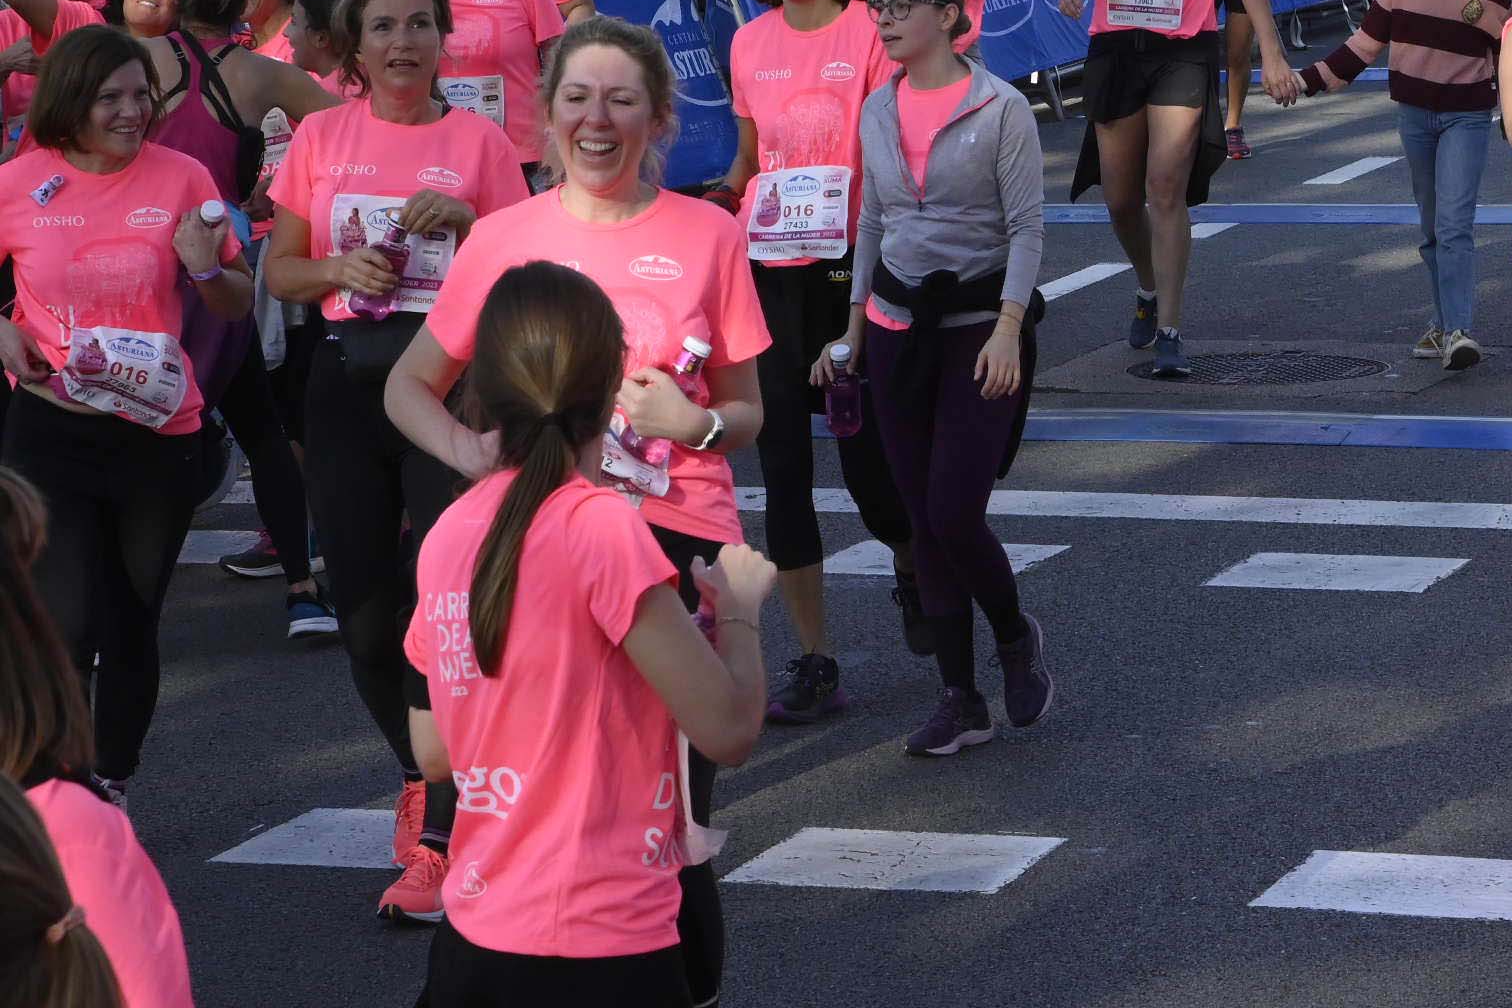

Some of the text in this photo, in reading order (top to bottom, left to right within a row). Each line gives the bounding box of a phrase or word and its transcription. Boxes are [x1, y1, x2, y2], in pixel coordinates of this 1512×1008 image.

[755, 68, 792, 81] OYSHO
[783, 203, 814, 218] 016
[33, 215, 85, 228] OYSHO
[783, 220, 809, 230] 27433
[401, 295, 435, 305] Santande
[110, 362, 149, 385] 016
[425, 591, 470, 622] CARR
